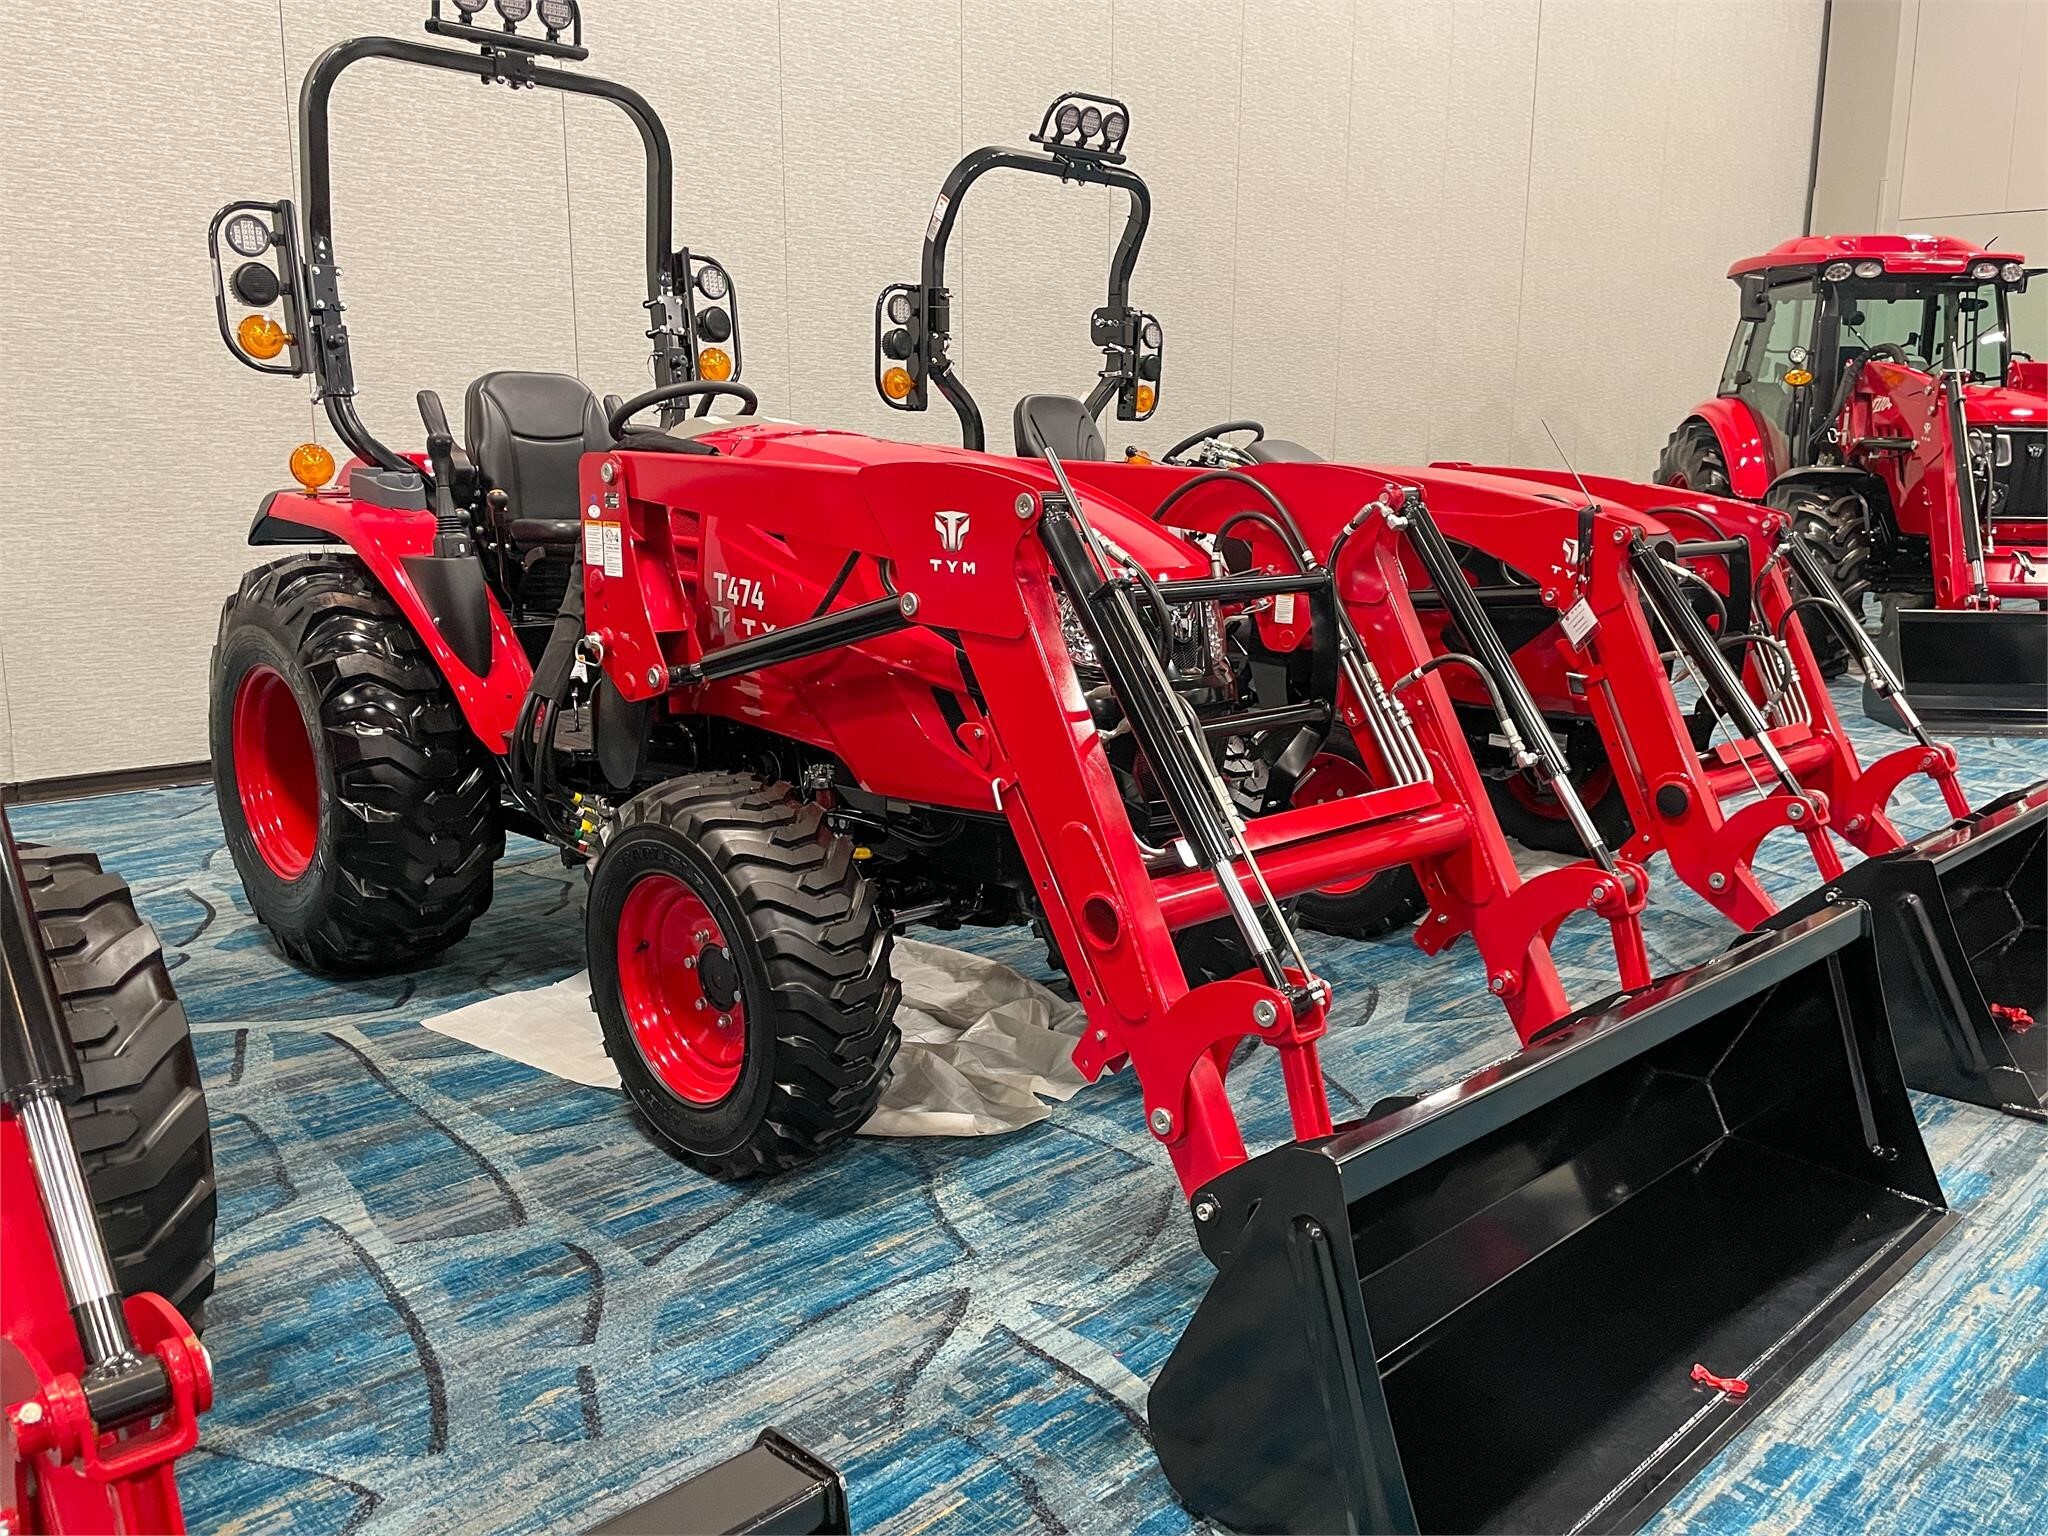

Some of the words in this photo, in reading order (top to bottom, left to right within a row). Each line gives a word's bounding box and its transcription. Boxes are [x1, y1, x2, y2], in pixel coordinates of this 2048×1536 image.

[929, 559, 976, 575] TYM
[713, 571, 764, 611] T474
[741, 617, 777, 636] TY
